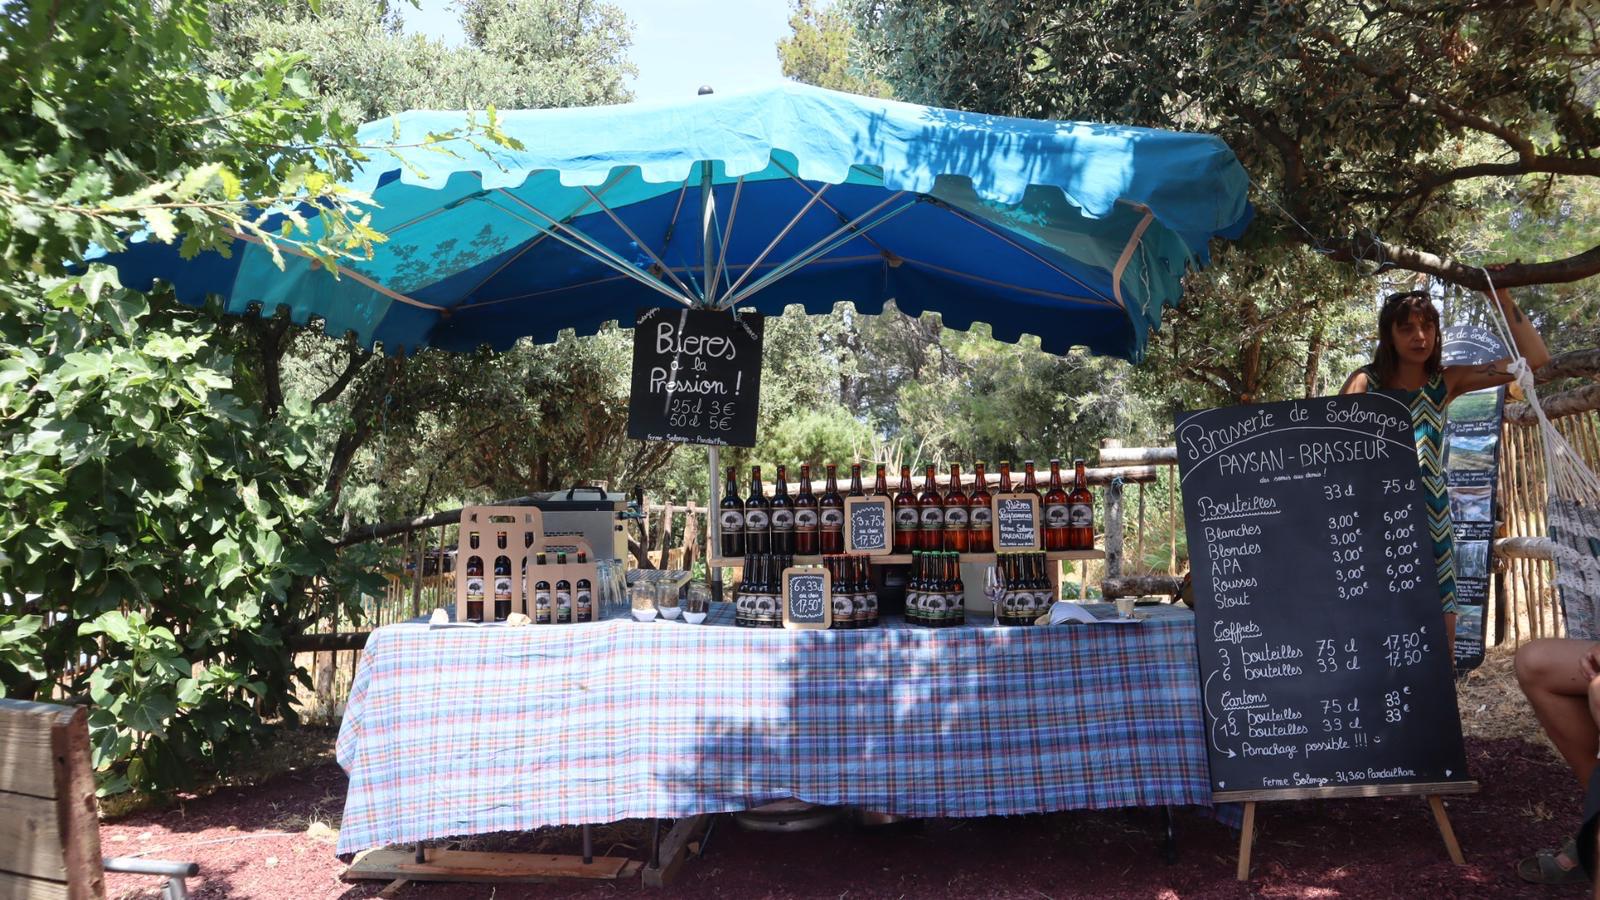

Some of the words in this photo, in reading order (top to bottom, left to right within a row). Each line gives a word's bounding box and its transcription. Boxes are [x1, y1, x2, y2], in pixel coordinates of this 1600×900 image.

[691, 356, 707, 372] la
[649, 367, 728, 395] Pression
[1180, 409, 1275, 461] Brasserie
[1290, 402, 1310, 422] de
[1326, 400, 1398, 438] Solongo
[1219, 448, 1285, 476] PAYSAN
[1300, 439, 1390, 468] BRASSEUR
[1323, 484, 1342, 500] 33
[1382, 479, 1401, 495] 75
[1197, 493, 1277, 517] Bouteilles
[1204, 523, 1262, 543] Blanches
[1208, 541, 1262, 561] Blondes
[1212, 576, 1258, 593] Rousses
[1214, 591, 1251, 610] Stout
[1213, 620, 1260, 645] Coffrets
[1218, 648, 1231, 667] 3
[1240, 642, 1304, 666] bouteilles
[1315, 638, 1336, 657] 75
[1344, 637, 1358, 653] cl
[1222, 666, 1232, 681] 6
[1243, 663, 1303, 681] bouteilles
[1316, 657, 1338, 673] 33
[1346, 655, 1361, 670] cl
[1220, 688, 1268, 708] Cartons
[1227, 710, 1236, 724] 6
[1247, 707, 1303, 726] bouteilles
[1320, 698, 1342, 715] 75
[1347, 697, 1360, 712] cl
[1219, 722, 1241, 737] 12
[1248, 723, 1309, 738] bouteilles
[1322, 717, 1343, 732] 33
[1348, 716, 1363, 729] cl
[1241, 741, 1299, 760] Panachage
[1305, 736, 1350, 759] possible
[1263, 776, 1290, 787] Ferme
[1292, 771, 1329, 788] Solongo
